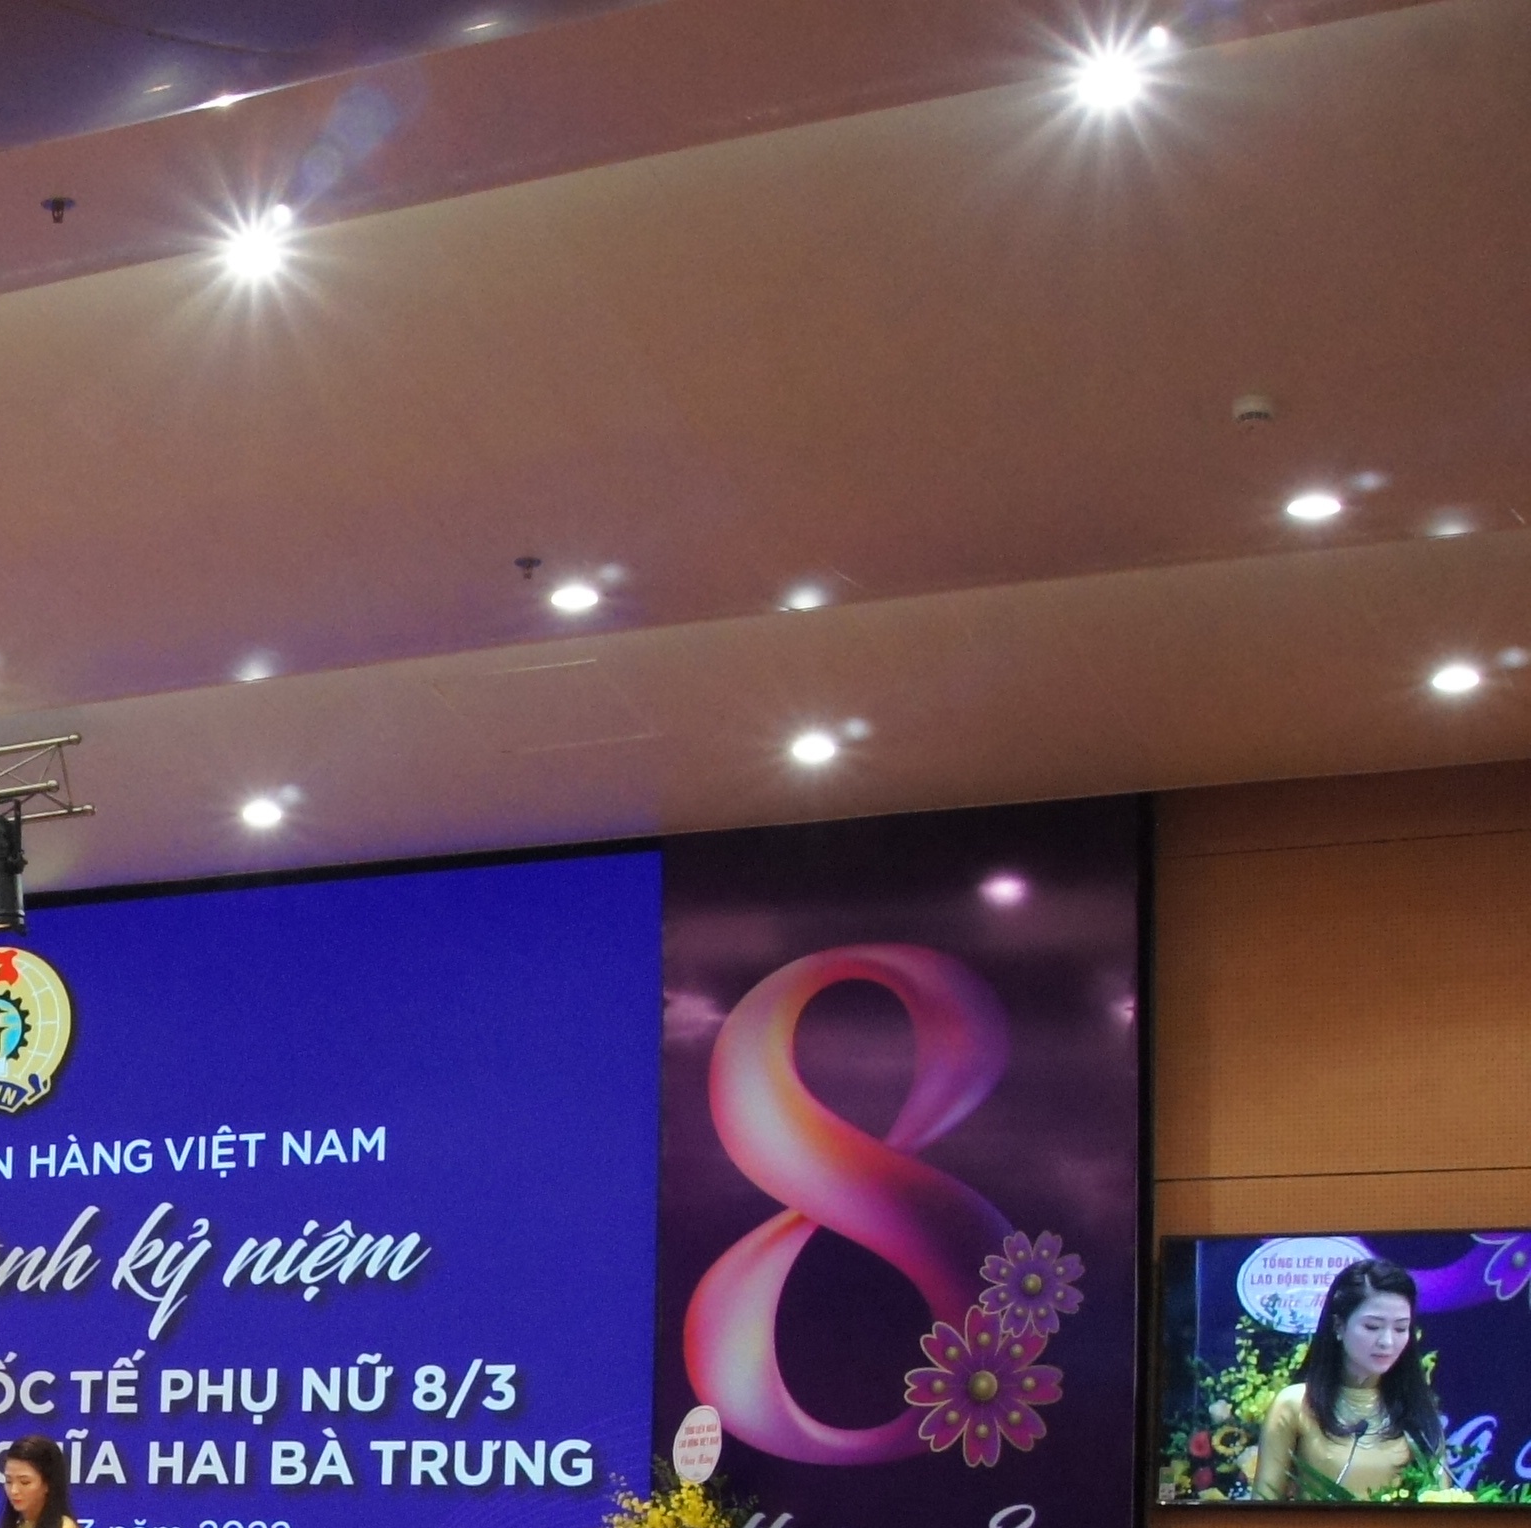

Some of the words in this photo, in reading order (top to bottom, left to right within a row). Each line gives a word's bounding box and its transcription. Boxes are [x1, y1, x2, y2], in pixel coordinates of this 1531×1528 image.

[29, 1134, 153, 1179] HÀNG
[164, 1125, 267, 1178] VIỆT
[282, 1126, 386, 1166] NAM
[684, 943, 1010, 1465] 8
[111, 1202, 212, 1341] kỷ
[223, 1219, 432, 1302] niệm
[70, 1349, 146, 1414] TẾ
[159, 1368, 278, 1425] PHỤ
[301, 1353, 395, 1412] NỮ
[412, 1358, 517, 1419] 8/3
[147, 1439, 247, 1485] HAI
[270, 1427, 355, 1486] BÀ
[369, 1438, 594, 1487] TRƯNG
